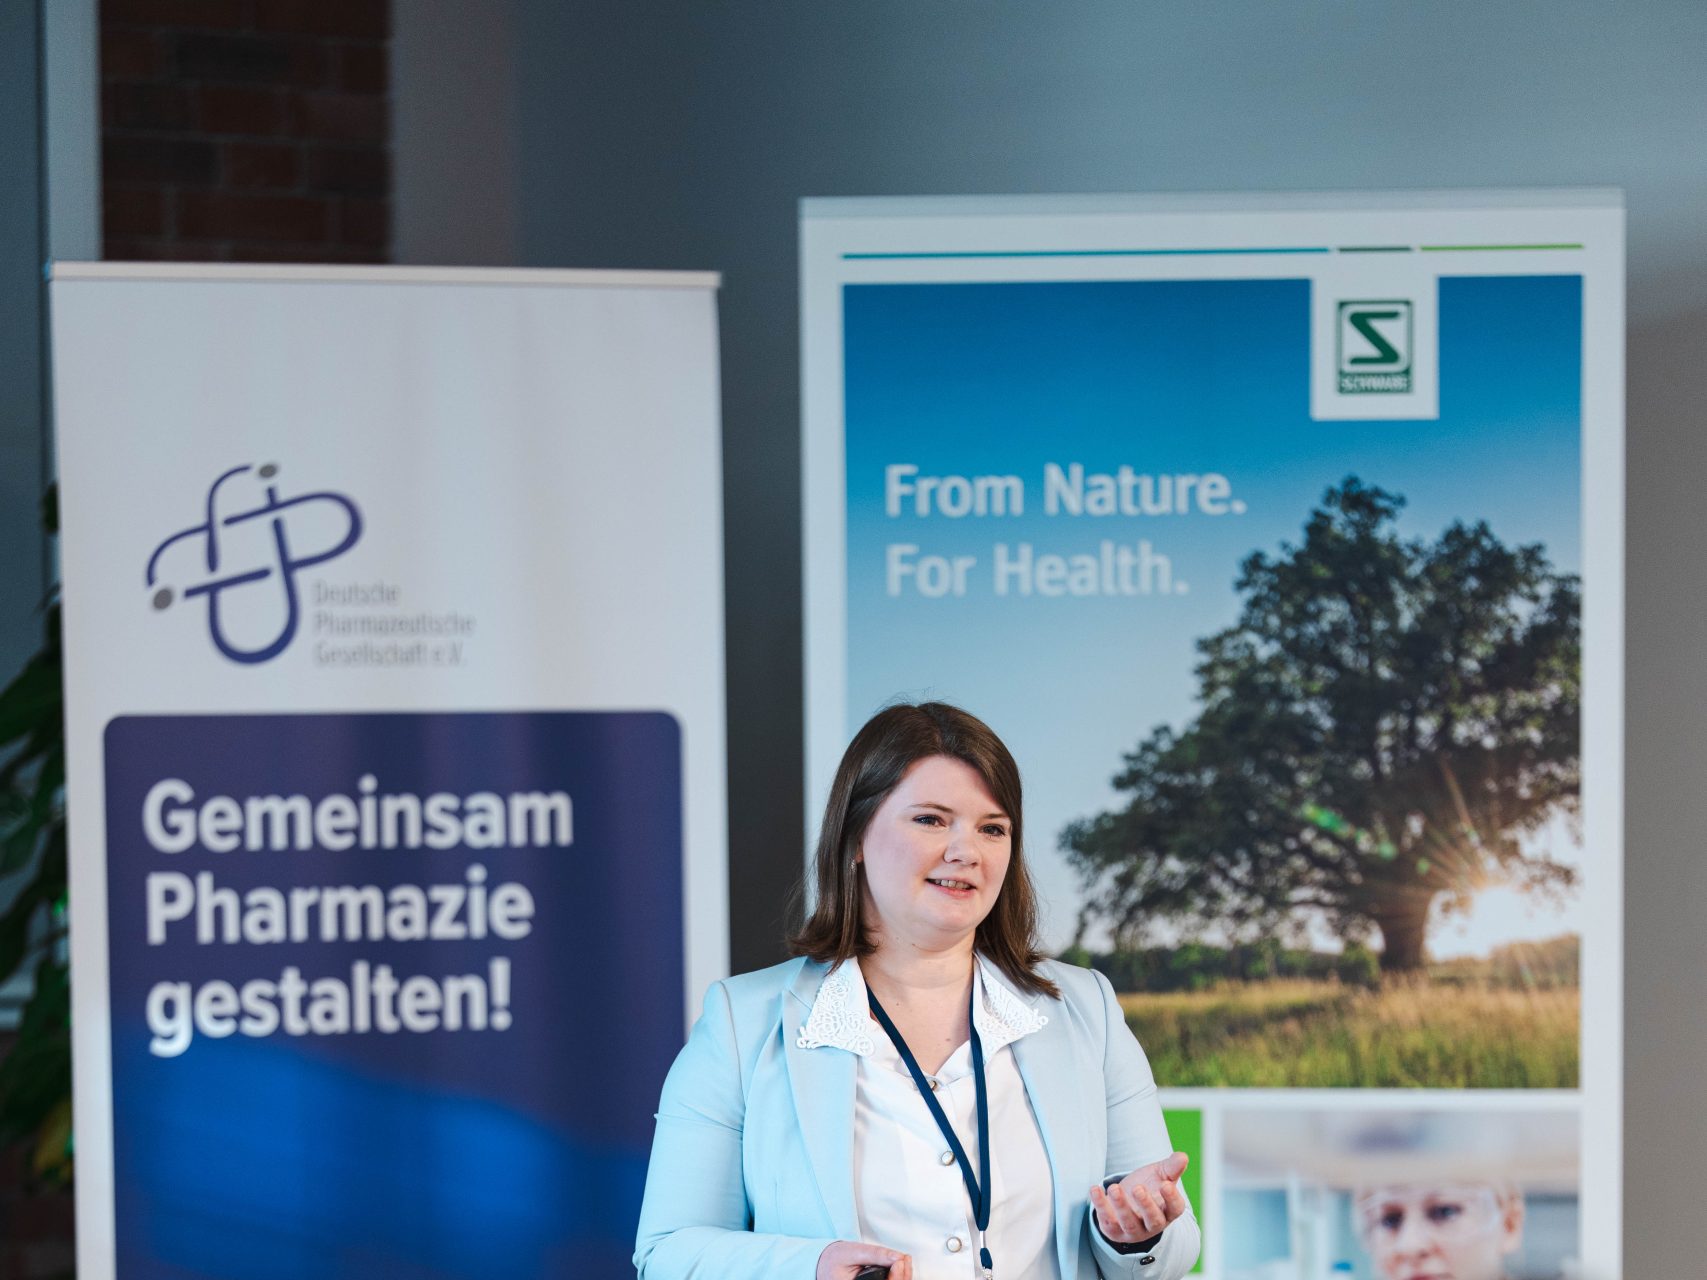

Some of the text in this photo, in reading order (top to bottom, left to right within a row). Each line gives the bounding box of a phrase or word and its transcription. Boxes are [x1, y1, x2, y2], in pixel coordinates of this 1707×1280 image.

[885, 461, 1248, 518] From Nature.
[314, 579, 401, 606] Deutsche
[884, 540, 1191, 598] For Health.
[314, 609, 475, 637] Pharmazeutische
[143, 774, 574, 855] Gemeinsam
[146, 864, 536, 946] Pharmazie
[146, 957, 513, 1059] gestalten!
